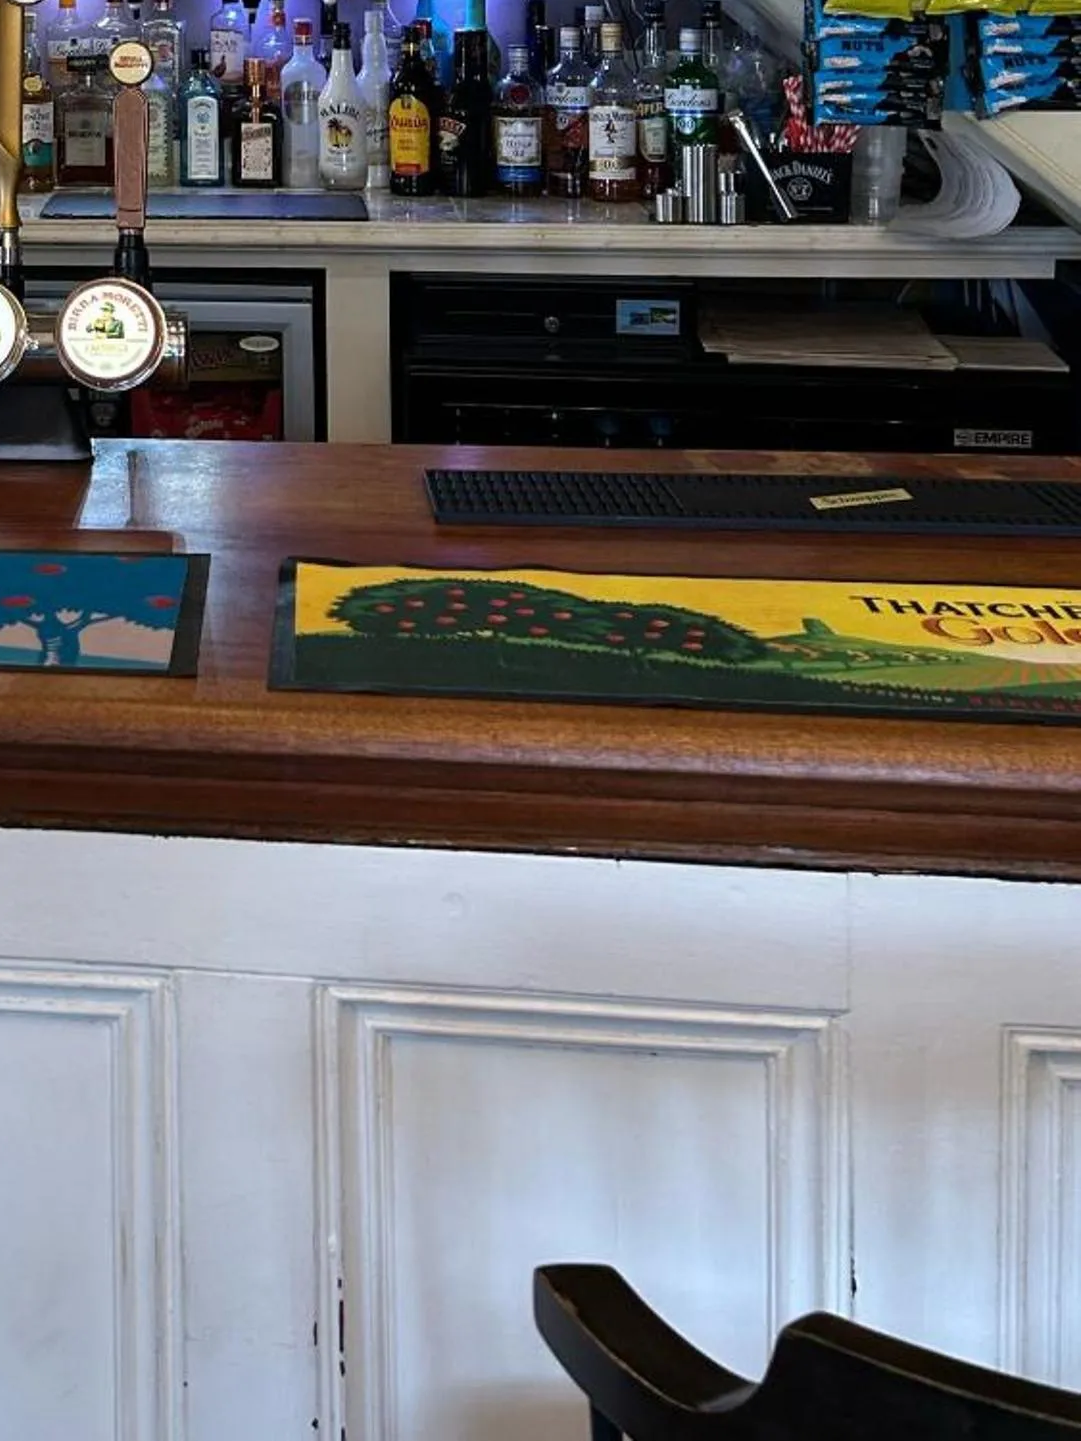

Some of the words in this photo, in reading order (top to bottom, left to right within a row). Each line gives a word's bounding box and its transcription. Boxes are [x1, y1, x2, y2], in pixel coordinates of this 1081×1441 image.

[841, 40, 884, 53] NUTS
[68, 294, 100, 332] BIRRA
[102, 291, 149, 333] MORETTI
[974, 431, 1031, 445] EMPIRE
